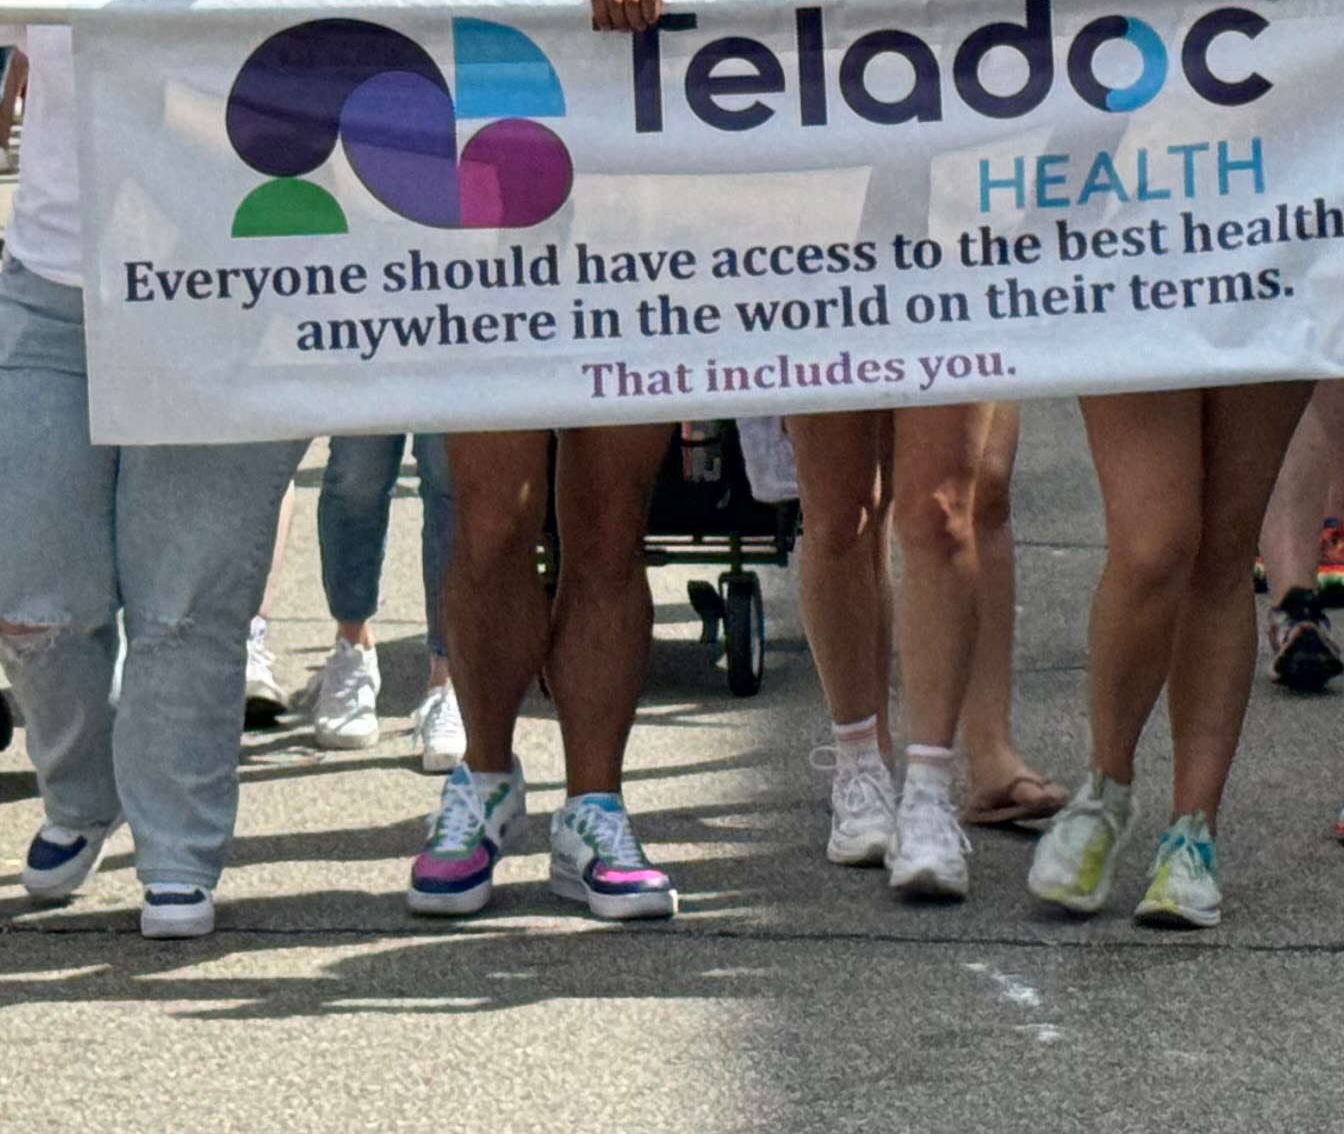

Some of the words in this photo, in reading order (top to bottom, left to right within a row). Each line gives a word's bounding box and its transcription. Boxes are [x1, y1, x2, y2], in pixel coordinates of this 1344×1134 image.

[979, 137, 1267, 213] HEALTH
[124, 261, 367, 309] Everyone
[383, 243, 561, 292] should
[575, 242, 697, 285] have
[712, 239, 878, 278] access
[893, 232, 944, 270] to
[958, 224, 1042, 266] the
[1055, 216, 1168, 262] best
[297, 303, 557, 359] anywhere
[572, 299, 622, 340] in
[637, 294, 722, 337] the
[735, 285, 888, 334] world
[905, 296, 971, 323] on
[986, 276, 1113, 320] their
[1130, 266, 1295, 310] terms.
[582, 359, 694, 399] That
[706, 351, 906, 392] includes
[918, 353, 1017, 391] you.
